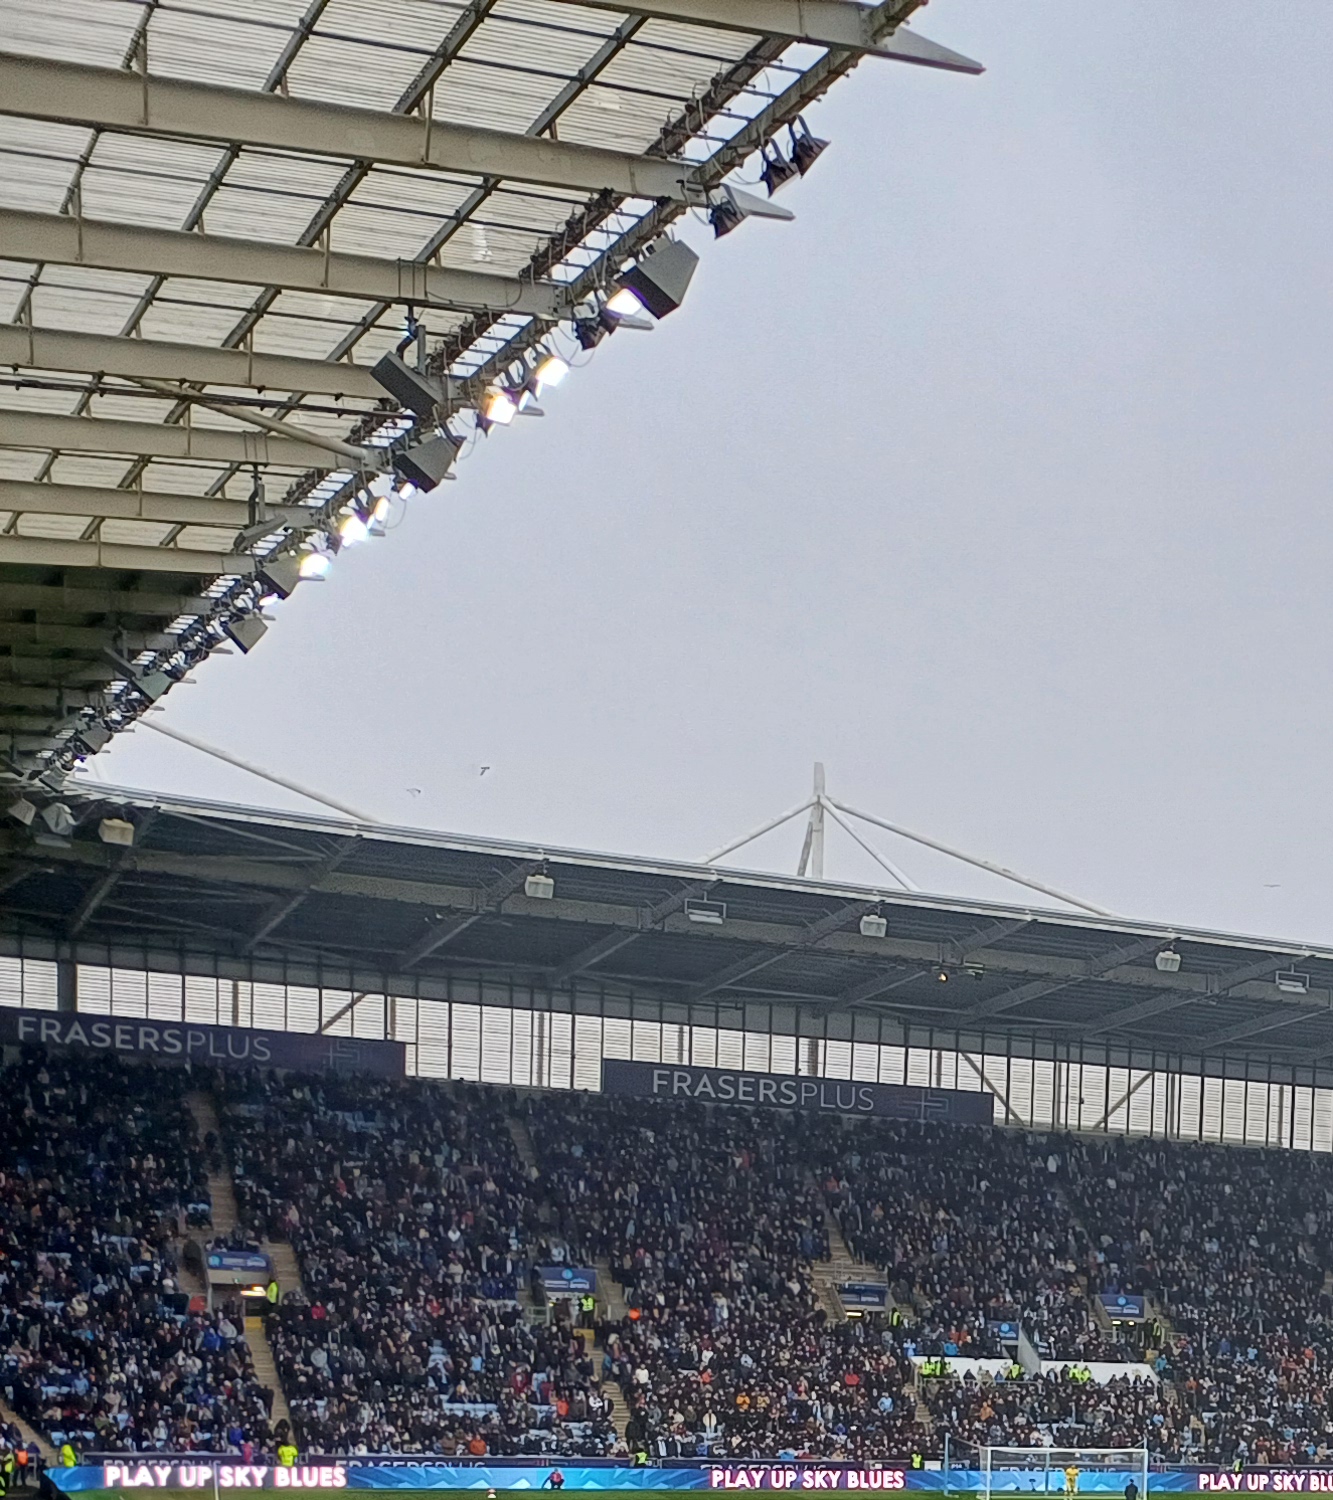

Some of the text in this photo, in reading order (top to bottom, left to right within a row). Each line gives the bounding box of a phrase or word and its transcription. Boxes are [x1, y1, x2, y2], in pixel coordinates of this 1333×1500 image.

[18, 1016, 271, 1062] FRASERSPLUS
[652, 1069, 874, 1111] FRASERSPLUS
[105, 1466, 347, 1487] PLAY UP SKY BLUES
[711, 1470, 905, 1489] PLAY UP SKY BLUES
[1199, 1474, 1242, 1490] PLAY
[1247, 1474, 1269, 1490] UP
[1273, 1475, 1305, 1491] SKY
